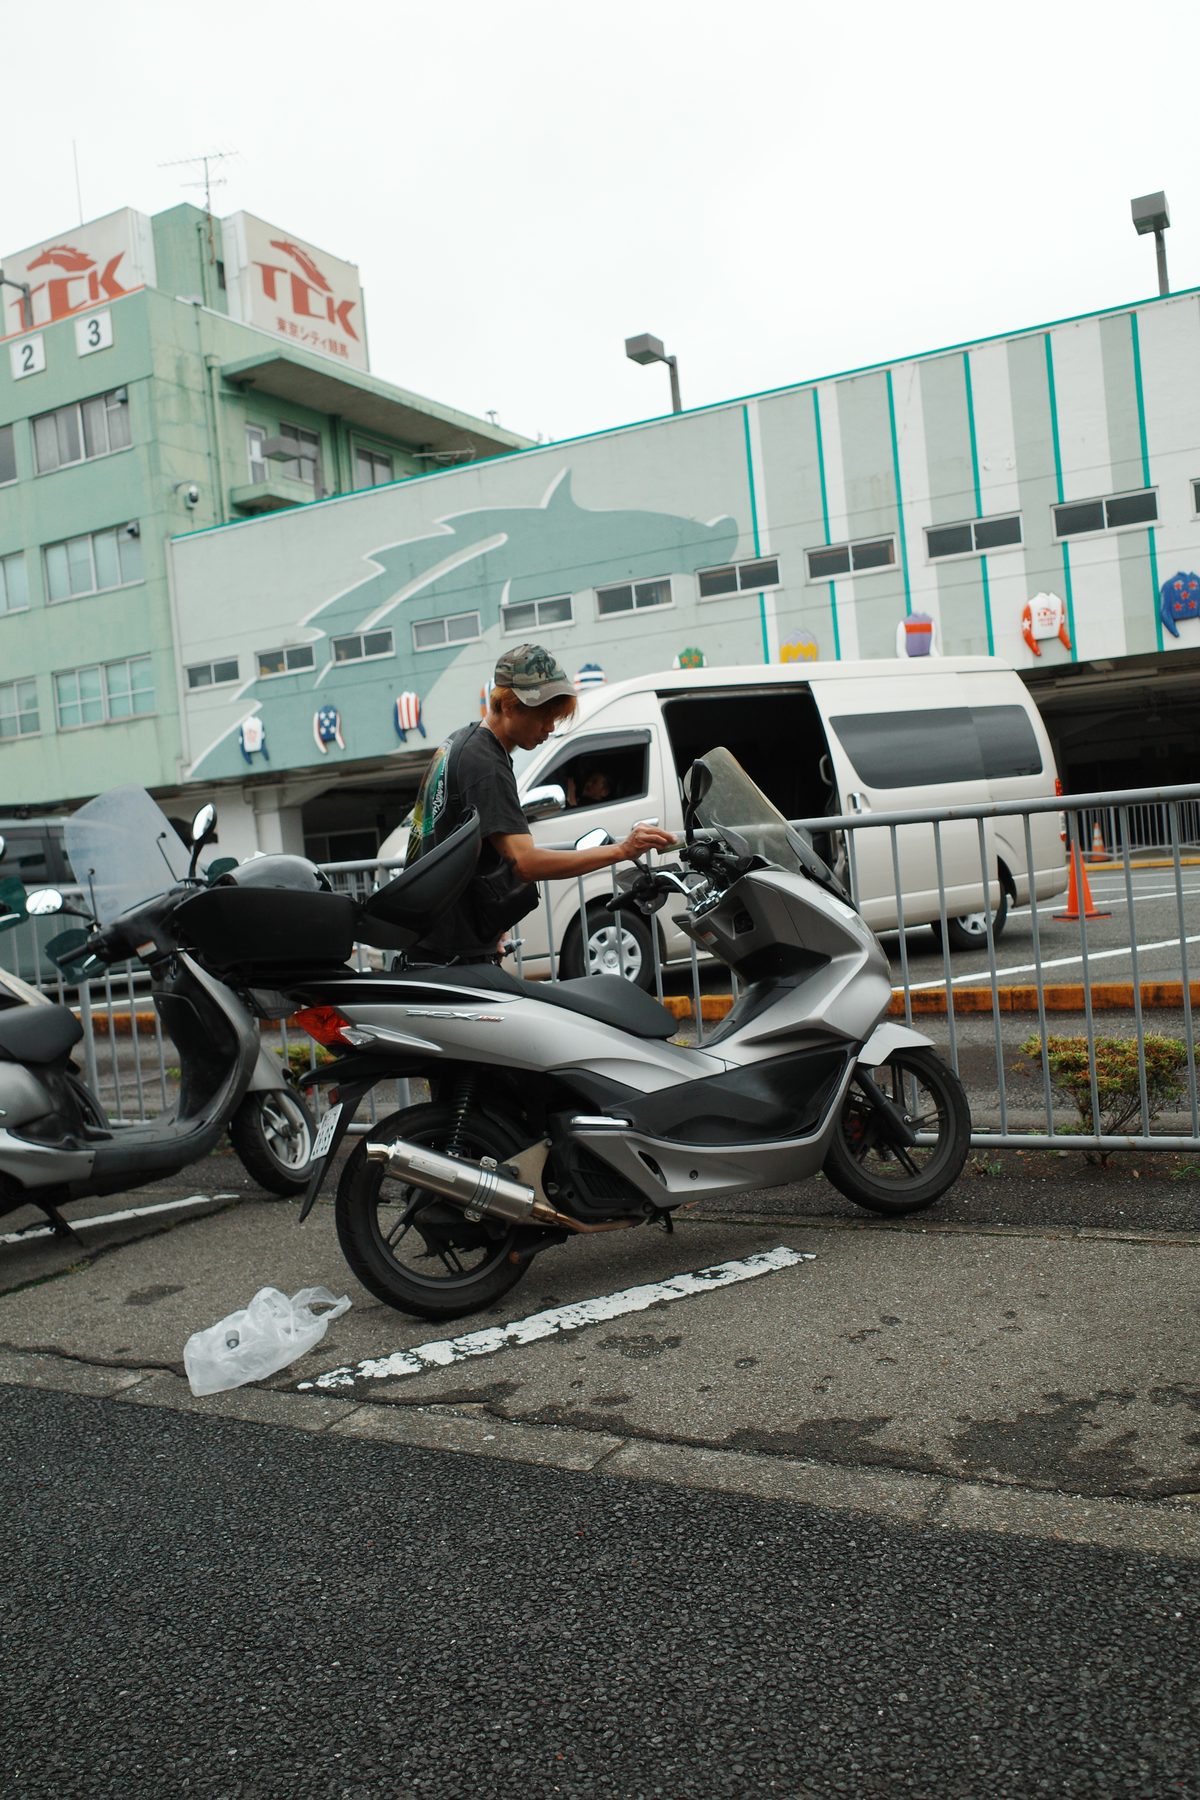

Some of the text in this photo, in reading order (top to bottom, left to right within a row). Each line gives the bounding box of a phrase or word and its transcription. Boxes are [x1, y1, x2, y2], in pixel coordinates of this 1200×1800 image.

[9, 251, 128, 332] TCK
[252, 261, 359, 341] TCK
[22, 344, 35, 371] 2
[87, 319, 101, 347] 3
